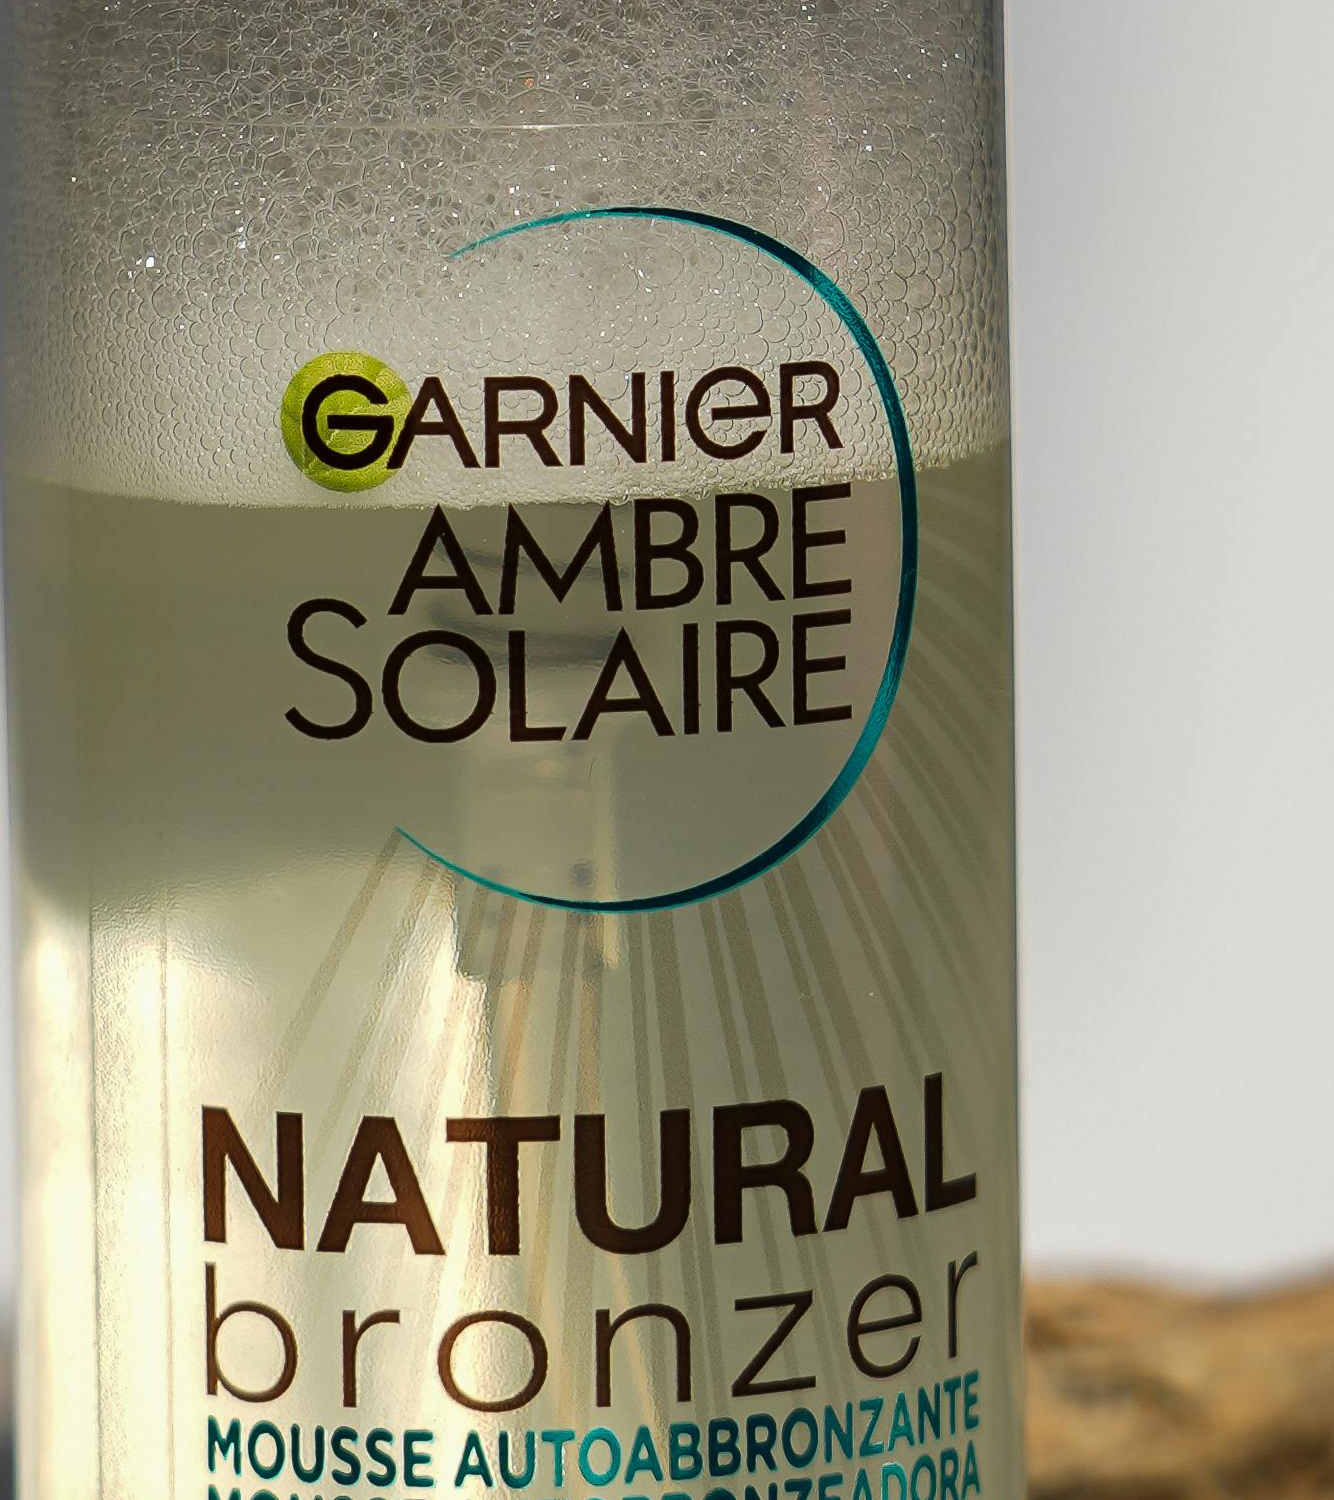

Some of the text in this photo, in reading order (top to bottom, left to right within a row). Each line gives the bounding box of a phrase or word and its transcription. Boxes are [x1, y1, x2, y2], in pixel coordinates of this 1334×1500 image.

[388, 482, 853, 615] AMBRE
[284, 597, 853, 743] SOLAIRE
[202, 1072, 978, 1256] NATURAL
[205, 1250, 979, 1414] bronzer
[207, 1370, 981, 1489] MOUSSE AUTOABBRONZANTE
